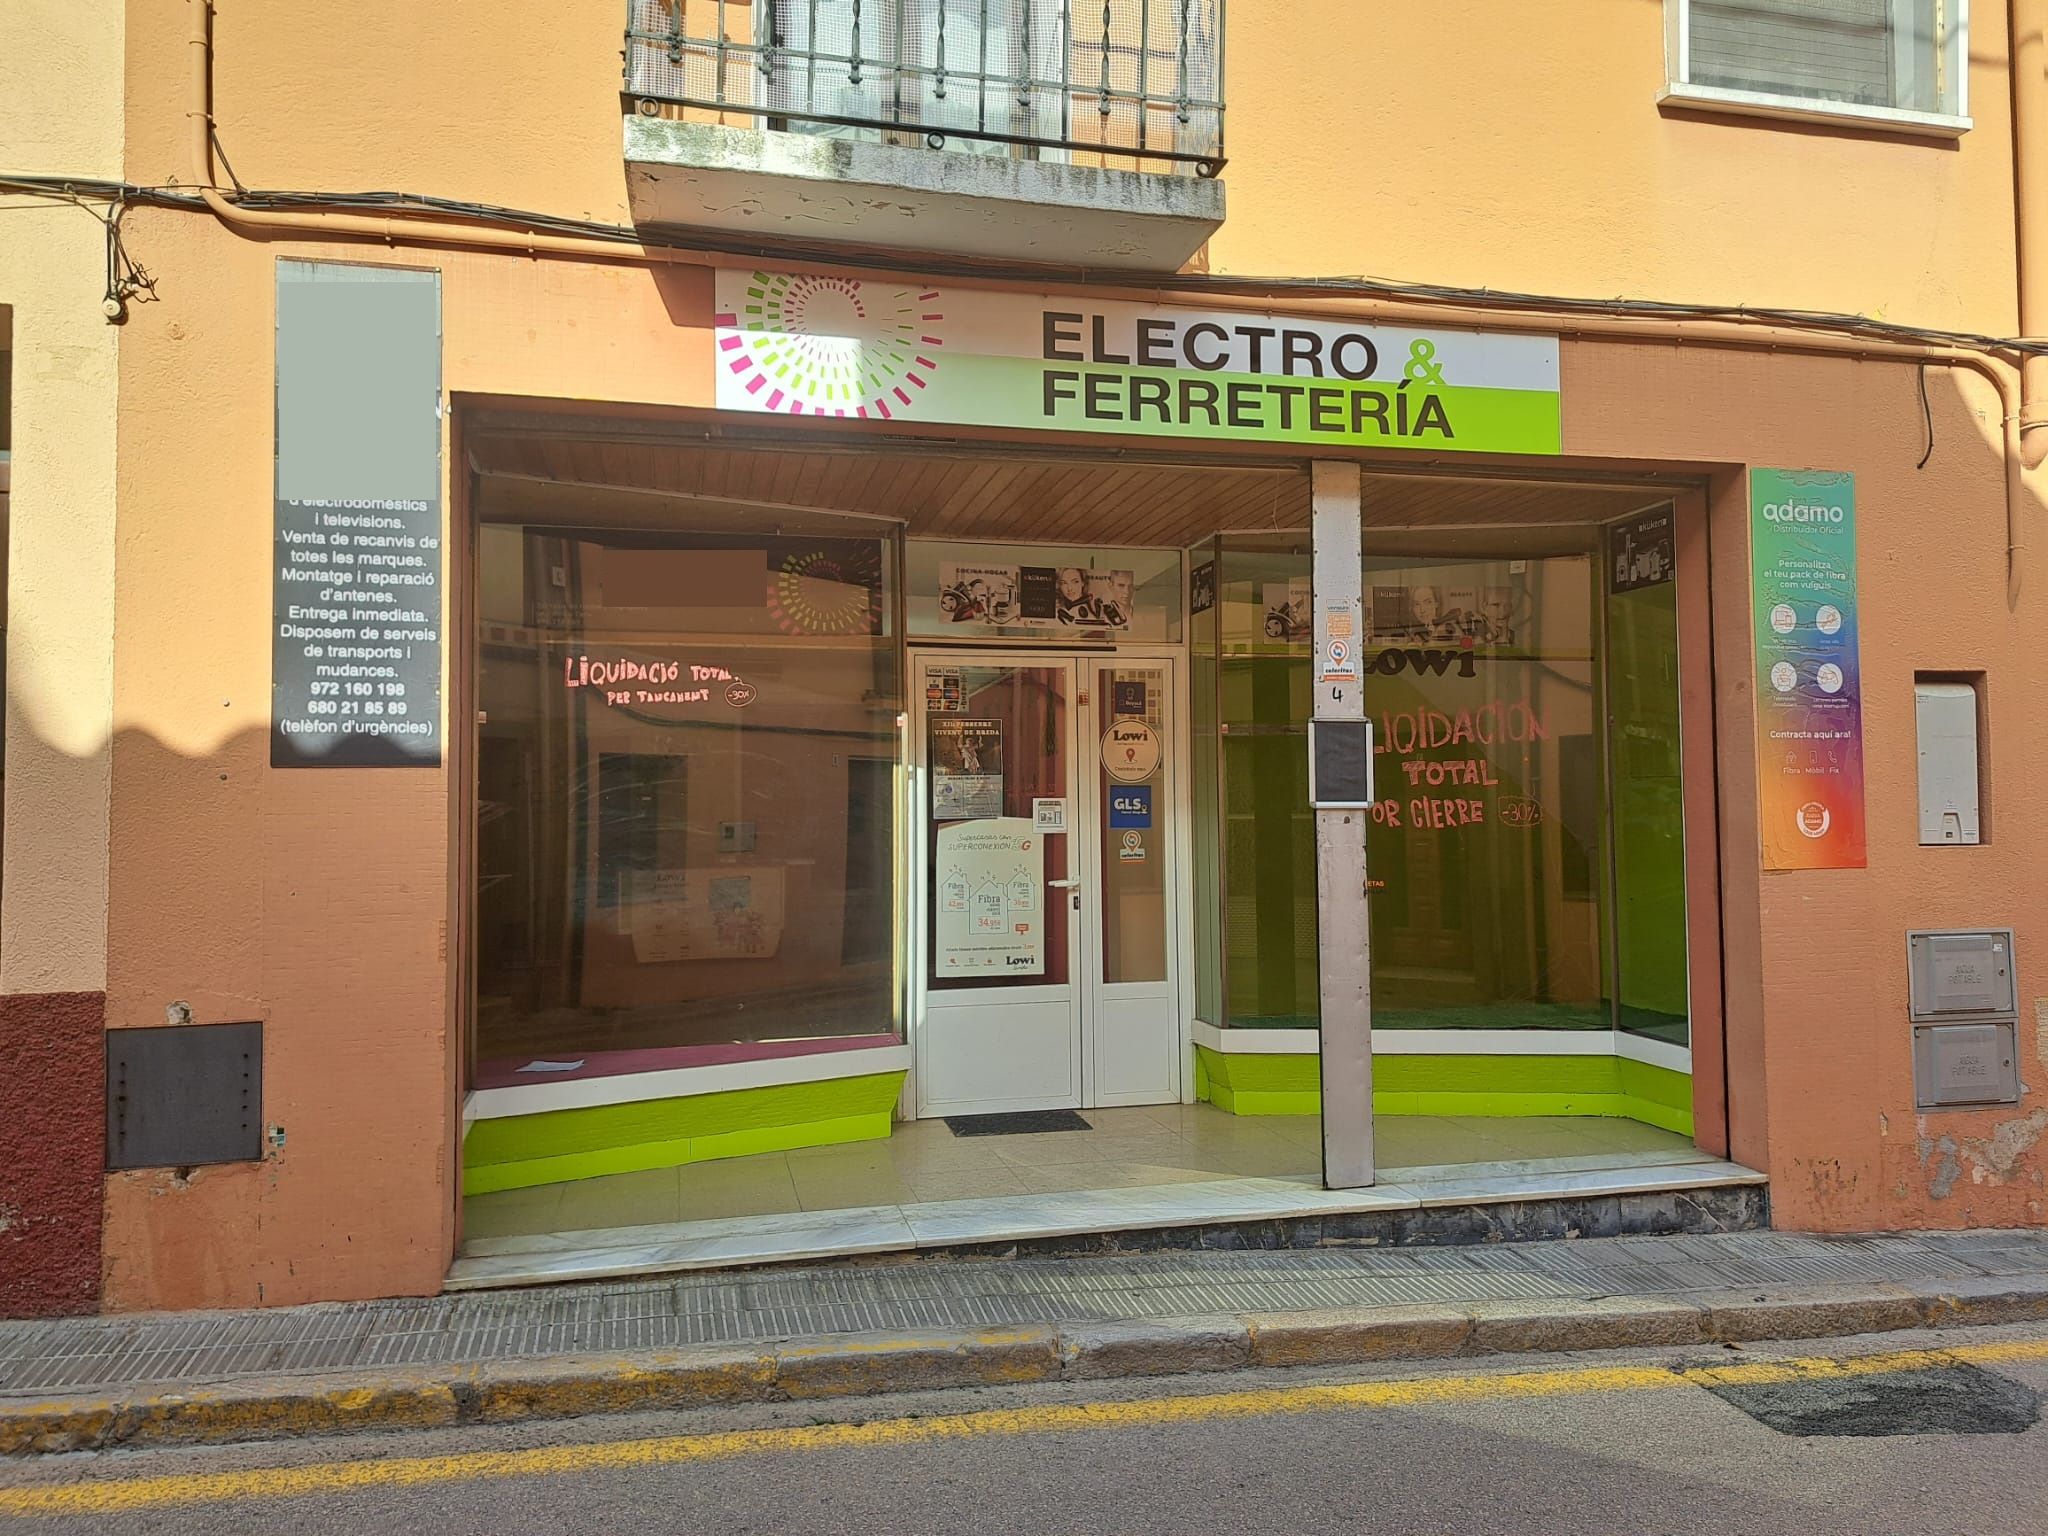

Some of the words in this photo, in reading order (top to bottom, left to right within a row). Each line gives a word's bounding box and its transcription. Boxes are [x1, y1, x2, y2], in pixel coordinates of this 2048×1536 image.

[1043, 311, 1378, 381] ELECTRO
[1403, 338, 1447, 384] &
[1043, 370, 1455, 438] FERRETERÍA
[1763, 499, 1844, 523] adamo
[315, 511, 319, 525] i
[323, 513, 406, 529] televisions.
[1773, 525, 1818, 534] Distribuidor
[1819, 526, 1844, 535] Oficial
[282, 529, 326, 545] Venta
[330, 531, 350, 546] de
[354, 534, 415, 548] recanvis
[419, 536, 438, 549] de
[290, 550, 328, 563] totes
[332, 551, 354, 565] les
[358, 554, 427, 568] marques.
[1778, 560, 1831, 569] Personalitza
[281, 567, 353, 586] Montatge
[357, 570, 361, 583] i
[366, 572, 435, 587] reparació
[1763, 569, 1772, 578] el
[1773, 570, 1789, 578] teu
[1790, 570, 1812, 580] pack
[1813, 570, 1825, 579] de
[1826, 570, 1846, 581] fibra
[1801, 581, 1832, 591] vulguis
[319, 587, 398, 603] d'antenes.
[288, 605, 348, 623] Entrega
[352, 607, 429, 623] inmediata.
[280, 624, 356, 641] Disposem
[360, 626, 379, 640] de
[383, 628, 437, 641] serveis
[303, 643, 323, 657] de
[327, 644, 403, 661] transports
[407, 646, 411, 659] i
[316, 663, 399, 677] mudances.
[564, 655, 679, 688] LIQUIDACIÓ
[690, 665, 732, 682] TOTAL
[310, 681, 340, 695] 972
[344, 682, 373, 696] 160
[377, 683, 405, 696] 198
[1332, 686, 1344, 703] 4
[607, 688, 631, 707] PER
[307, 700, 337, 714] 680
[341, 701, 359, 714] 21
[364, 701, 383, 715] 85
[387, 701, 407, 715] 89
[280, 718, 337, 735] (telèfon
[342, 719, 433, 737] d'urgències)
[1113, 729, 1148, 741] Lowi
[1769, 730, 1812, 739] Contracta
[1813, 729, 1833, 740] aquí
[1834, 730, 1851, 739] ara!
[1401, 759, 1499, 786] TOTAL
[1783, 766, 1801, 775] Fibra
[1829, 766, 1840, 775] Fix
[1113, 798, 1141, 810] GLS
[1371, 799, 1402, 828] OR
[1410, 795, 1484, 829] CIERRE
[1502, 802, 1539, 822] -30%
[977, 894, 1001, 904] Fibra
[1006, 954, 1035, 966] Lowi
